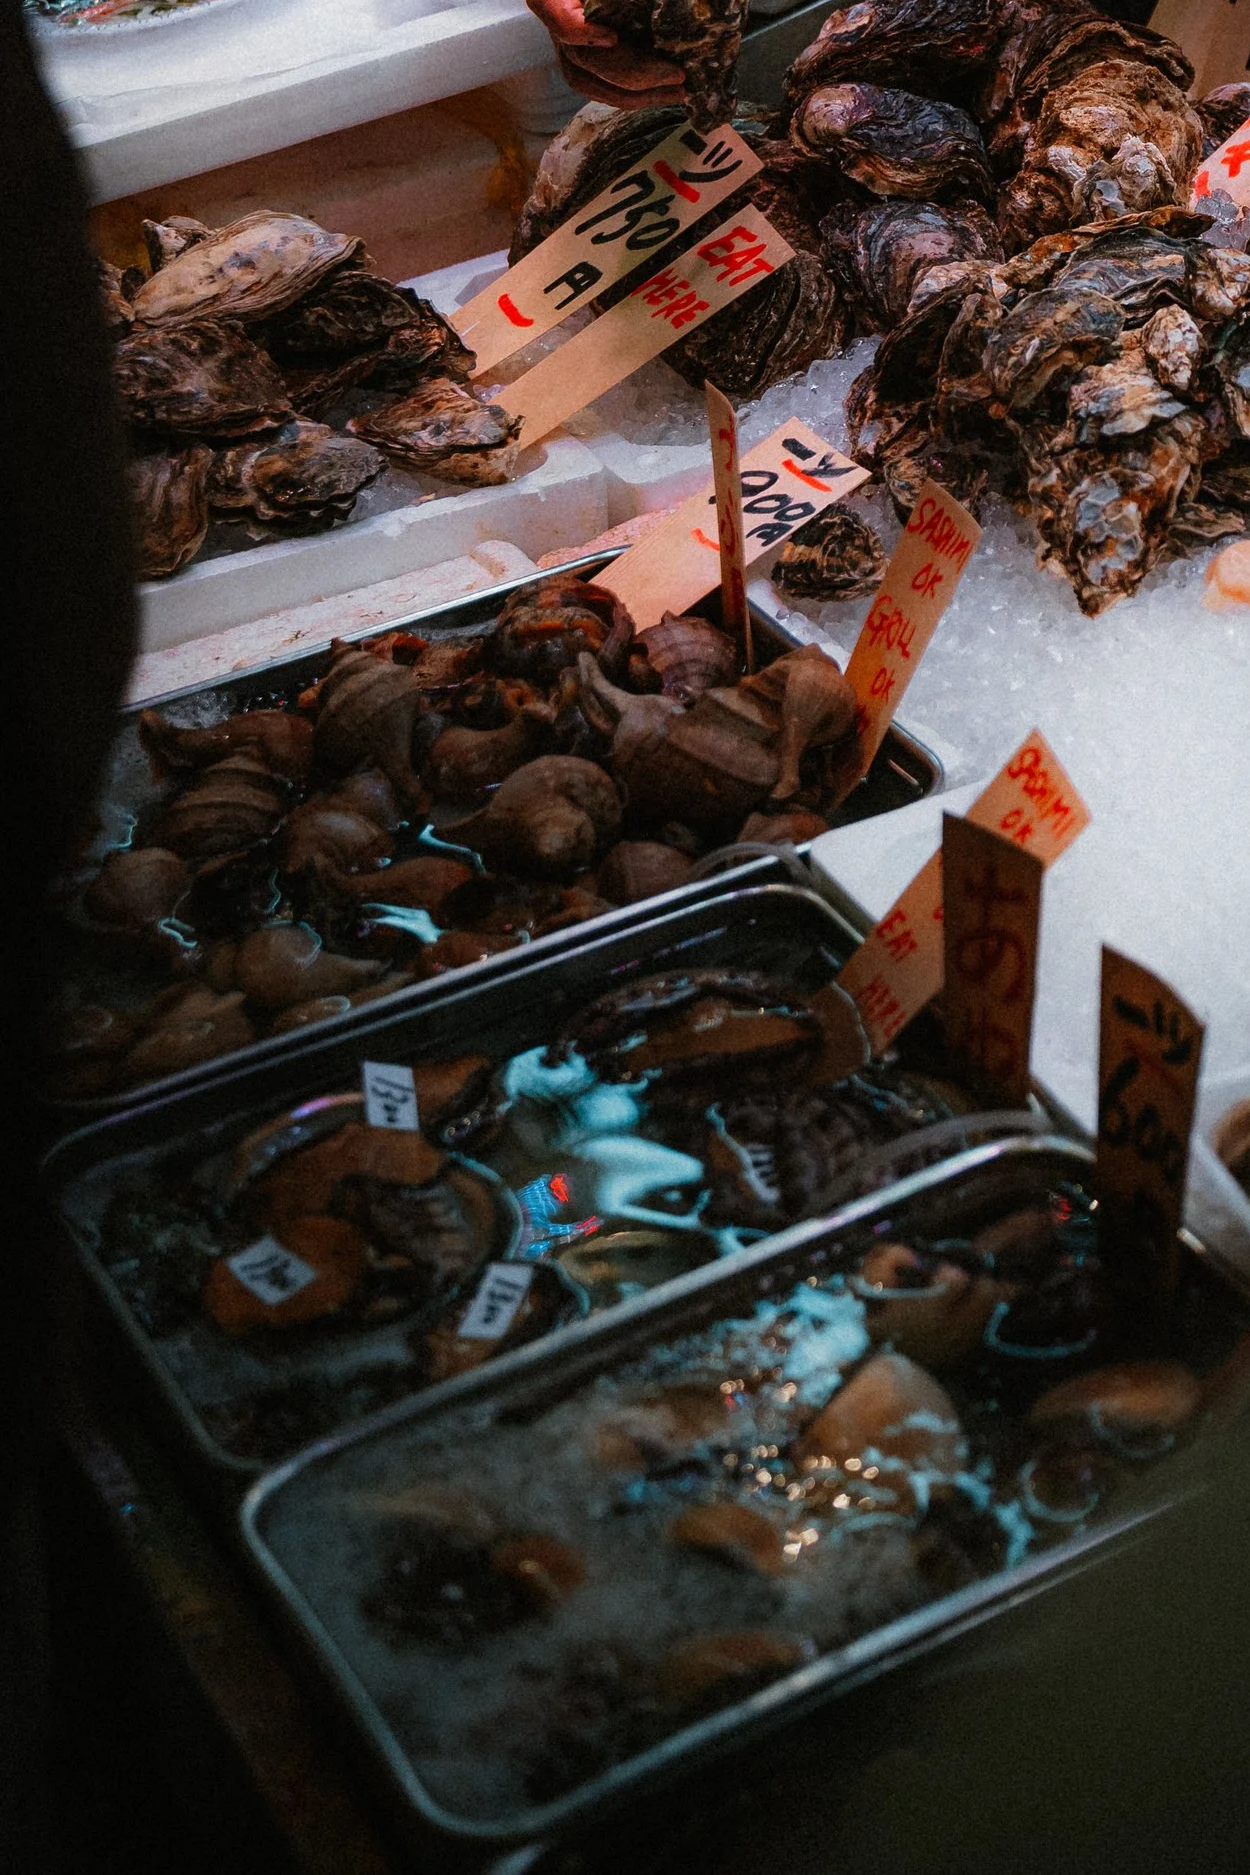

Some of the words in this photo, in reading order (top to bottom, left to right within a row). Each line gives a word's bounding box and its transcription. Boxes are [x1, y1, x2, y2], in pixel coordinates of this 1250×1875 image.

[574, 169, 682, 252] 750
[696, 225, 775, 288] EAT
[542, 260, 604, 311] 円
[629, 266, 711, 330] HERE
[911, 562, 944, 599] OK
[869, 666, 897, 704] OK
